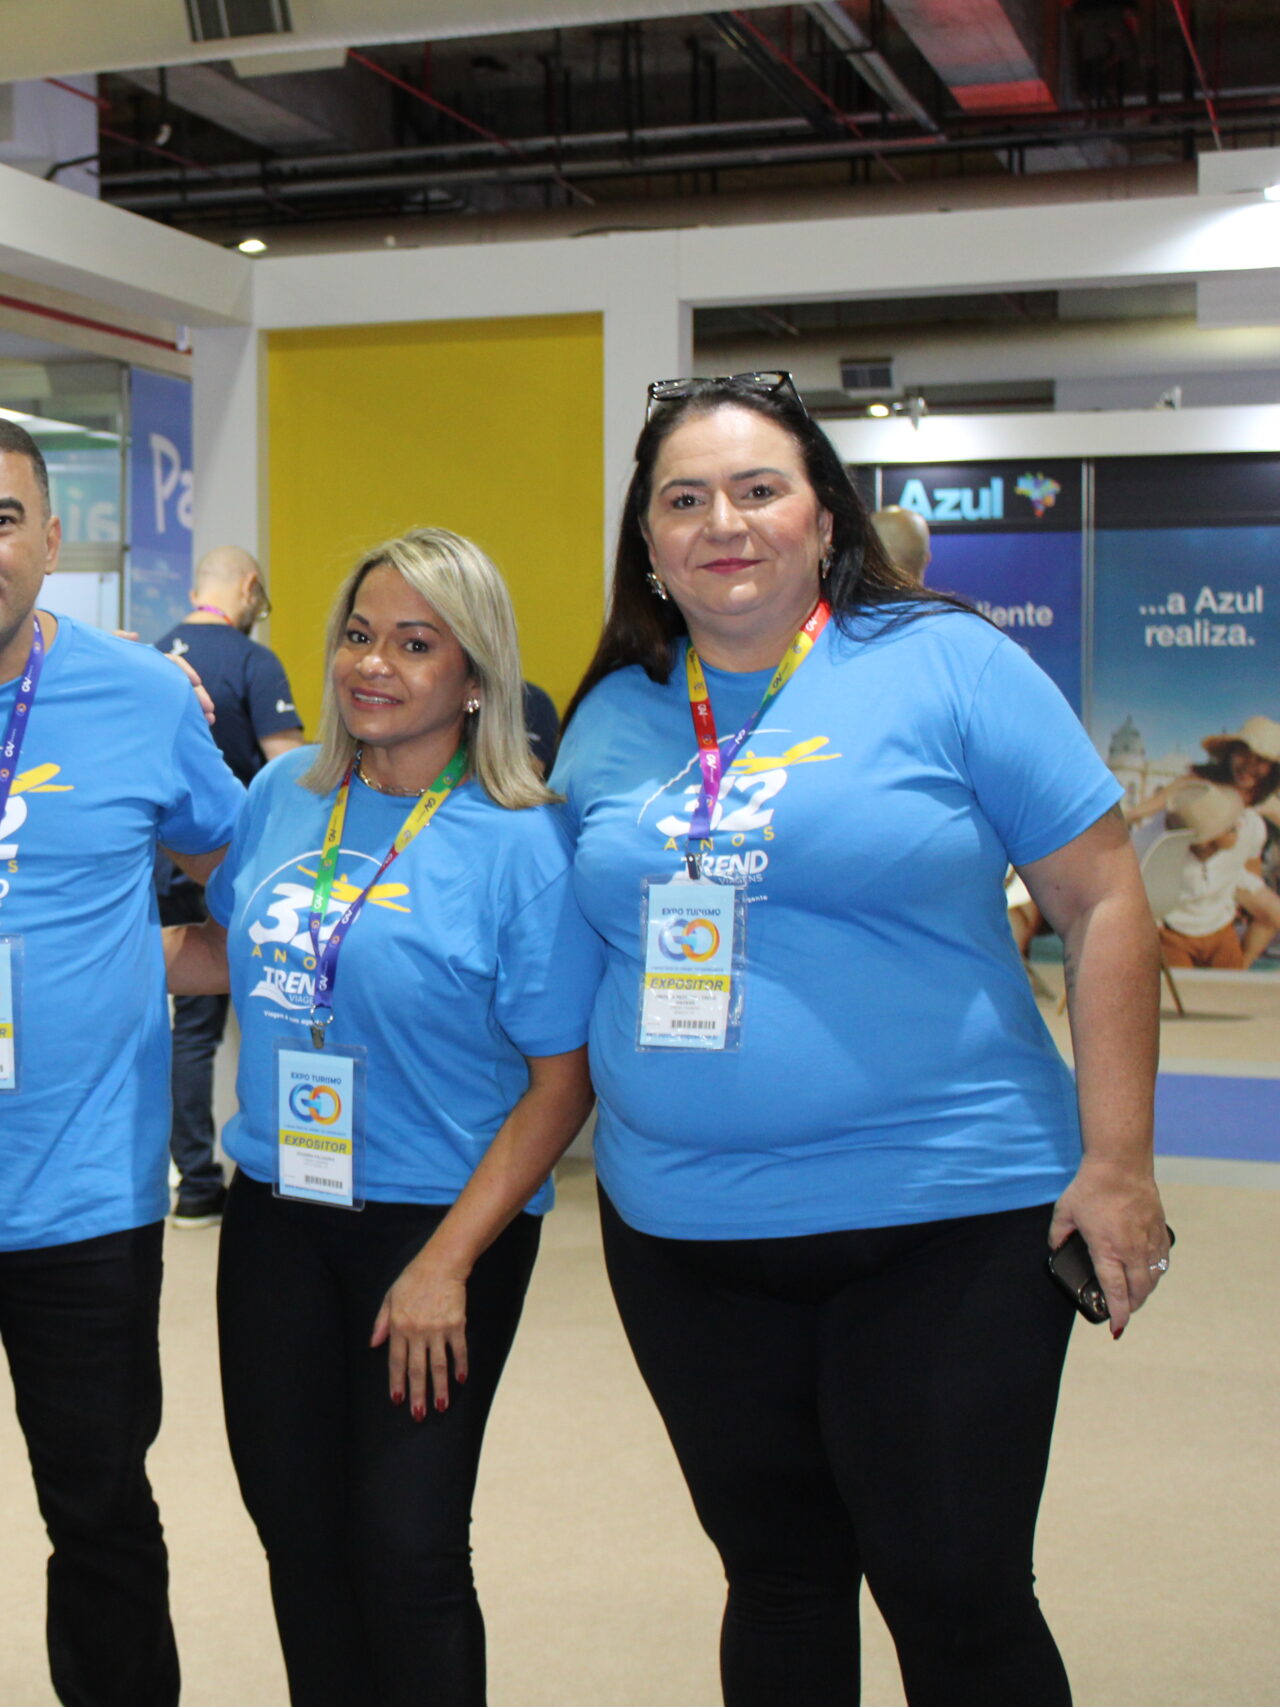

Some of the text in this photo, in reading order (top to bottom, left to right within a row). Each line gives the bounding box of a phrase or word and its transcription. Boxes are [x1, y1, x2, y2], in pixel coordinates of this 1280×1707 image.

[898, 476, 1005, 521] Azul
[1194, 586, 1264, 615] Azul
[1145, 619, 1256, 648] realiza.
[655, 768, 788, 838] 32
[248, 882, 361, 956] 32
[662, 907, 684, 916] EXPO
[251, 944, 318, 971] ANO
[262, 966, 316, 996] TREN
[650, 977, 724, 991] EXPOSITOR
[290, 1071, 342, 1085] EXPO TURISMO
[284, 1134, 348, 1154] EXPOSITOR
